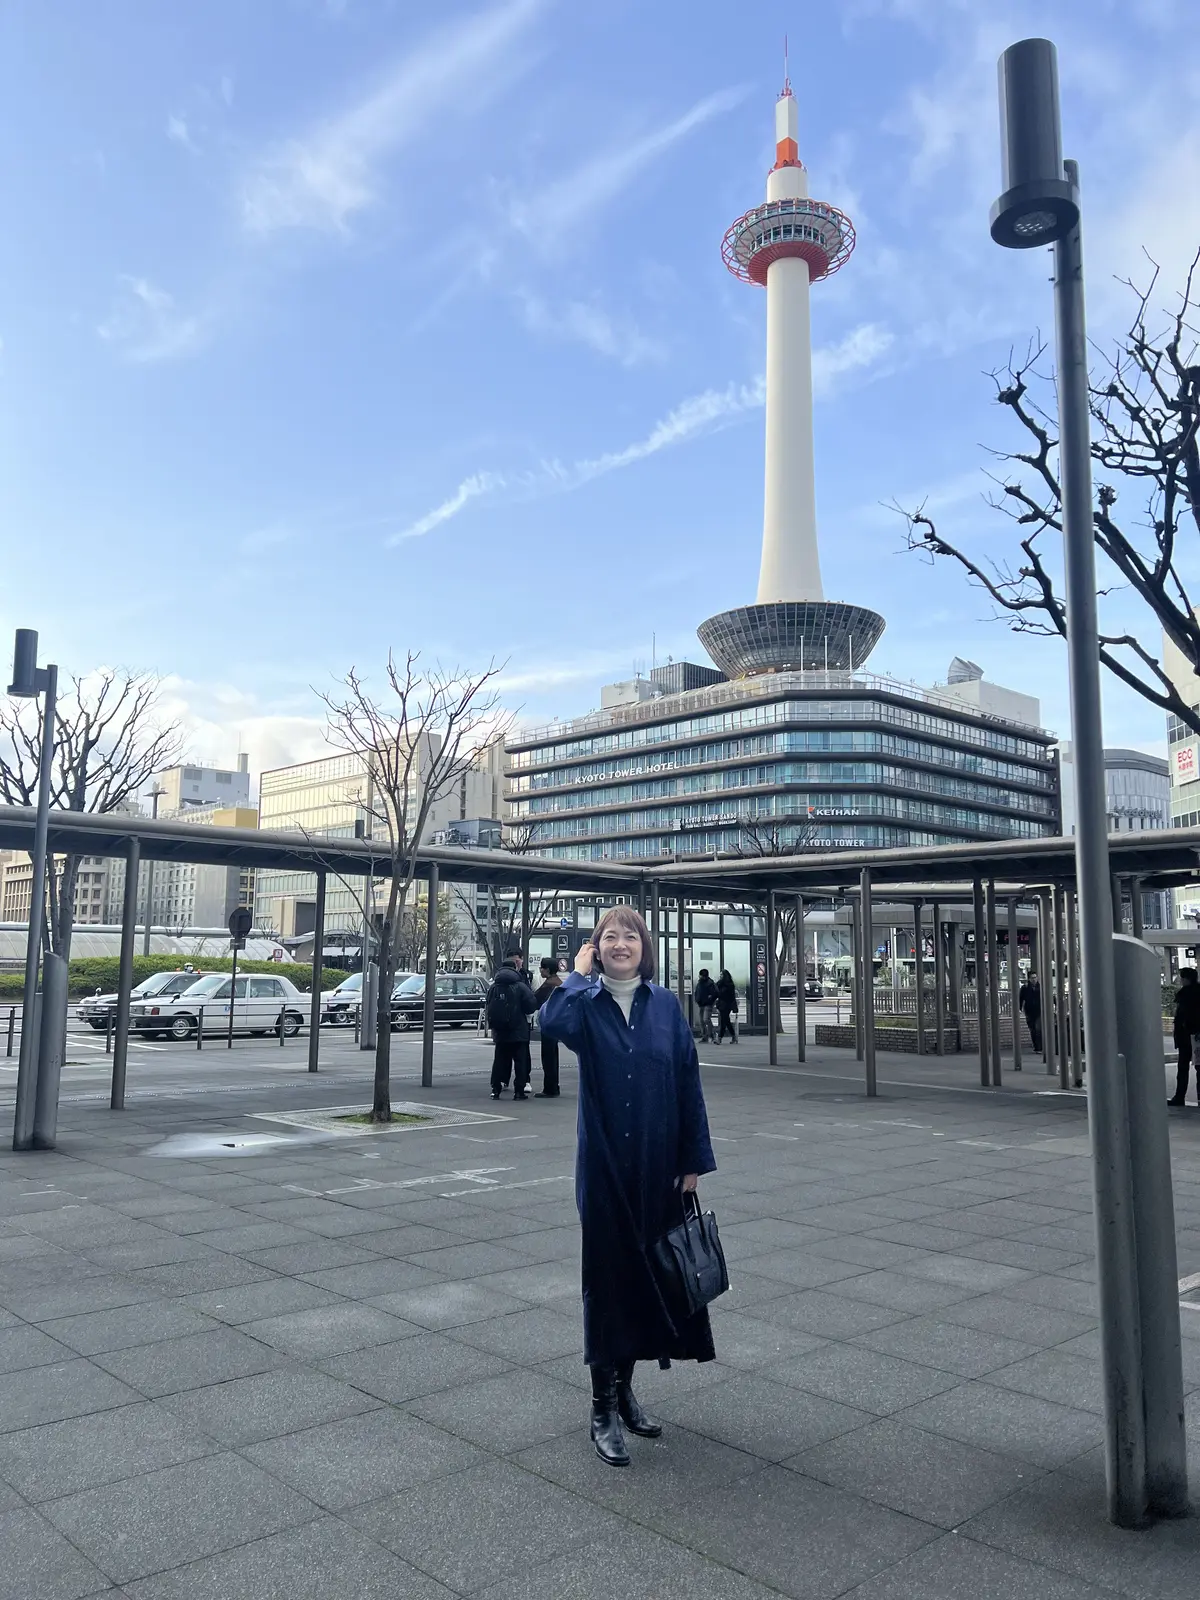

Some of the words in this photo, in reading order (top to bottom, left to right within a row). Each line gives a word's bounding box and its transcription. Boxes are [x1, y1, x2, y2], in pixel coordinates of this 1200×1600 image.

[575, 773, 605, 785] KYOTO
[608, 767, 642, 779] TOWER
[646, 761, 680, 774] HOTEL
[816, 807, 859, 816] KEIHAN
[833, 838, 865, 847] TOWER
